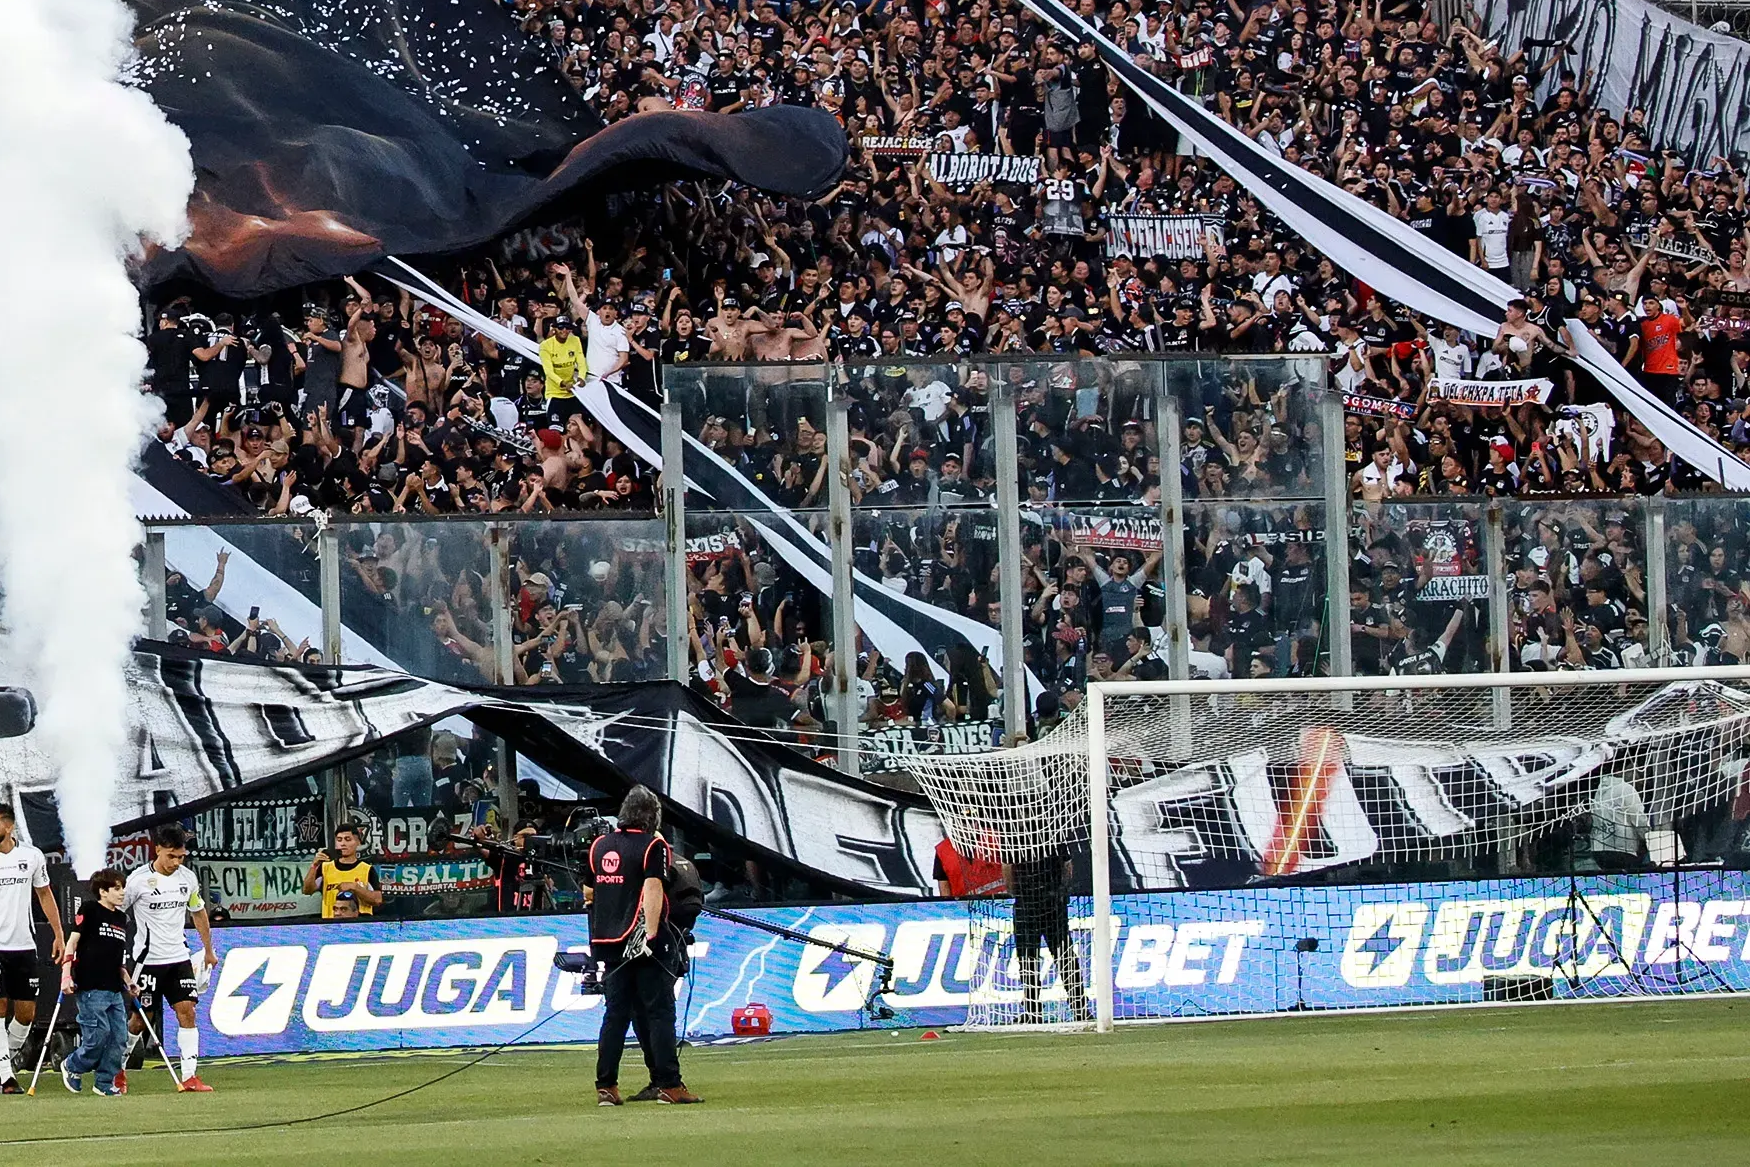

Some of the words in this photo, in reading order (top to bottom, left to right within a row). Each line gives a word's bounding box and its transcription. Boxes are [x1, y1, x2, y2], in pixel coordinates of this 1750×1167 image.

[930, 155, 1038, 183] ALBOROTADOS
[1046, 178, 1075, 202] 29
[195, 808, 225, 850] SAN
[401, 860, 494, 885] SALTO
[603, 858, 619, 867] TNT
[222, 865, 305, 900] CHMBA
[596, 875, 624, 884] SPORTS
[138, 974, 157, 992] 34
